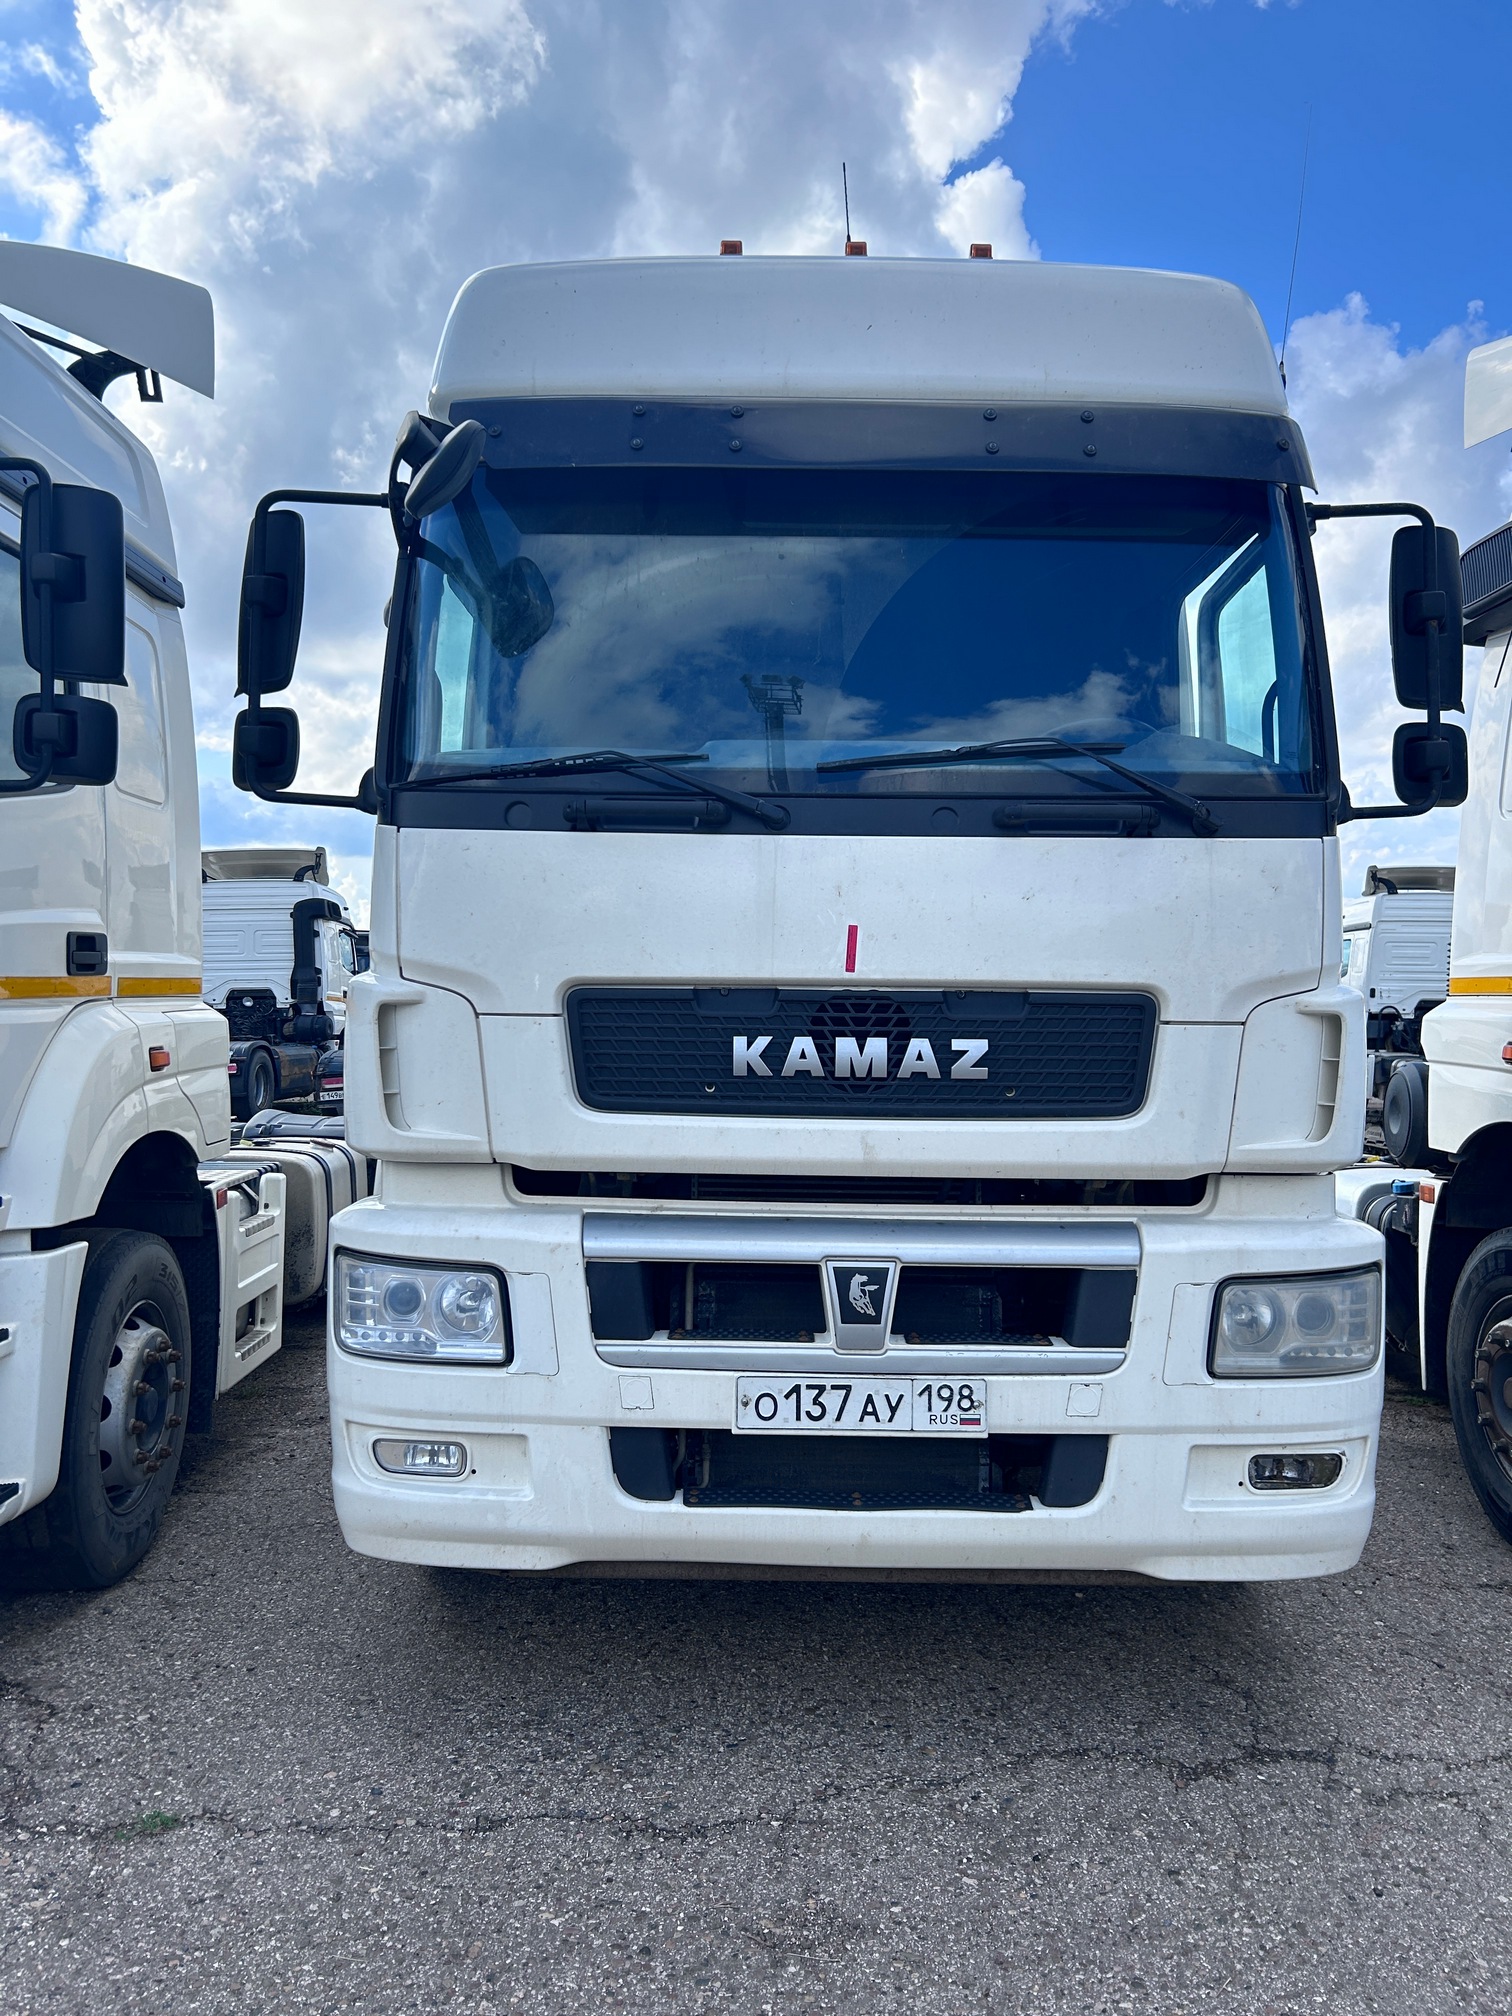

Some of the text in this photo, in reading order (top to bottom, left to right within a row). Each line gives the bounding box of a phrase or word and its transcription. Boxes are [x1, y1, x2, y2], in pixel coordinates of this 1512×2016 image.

[733, 1035, 989, 1080] KAMAZ
[754, 1384, 976, 1423] О137АУ 198
[929, 1414, 959, 1425] RUS
